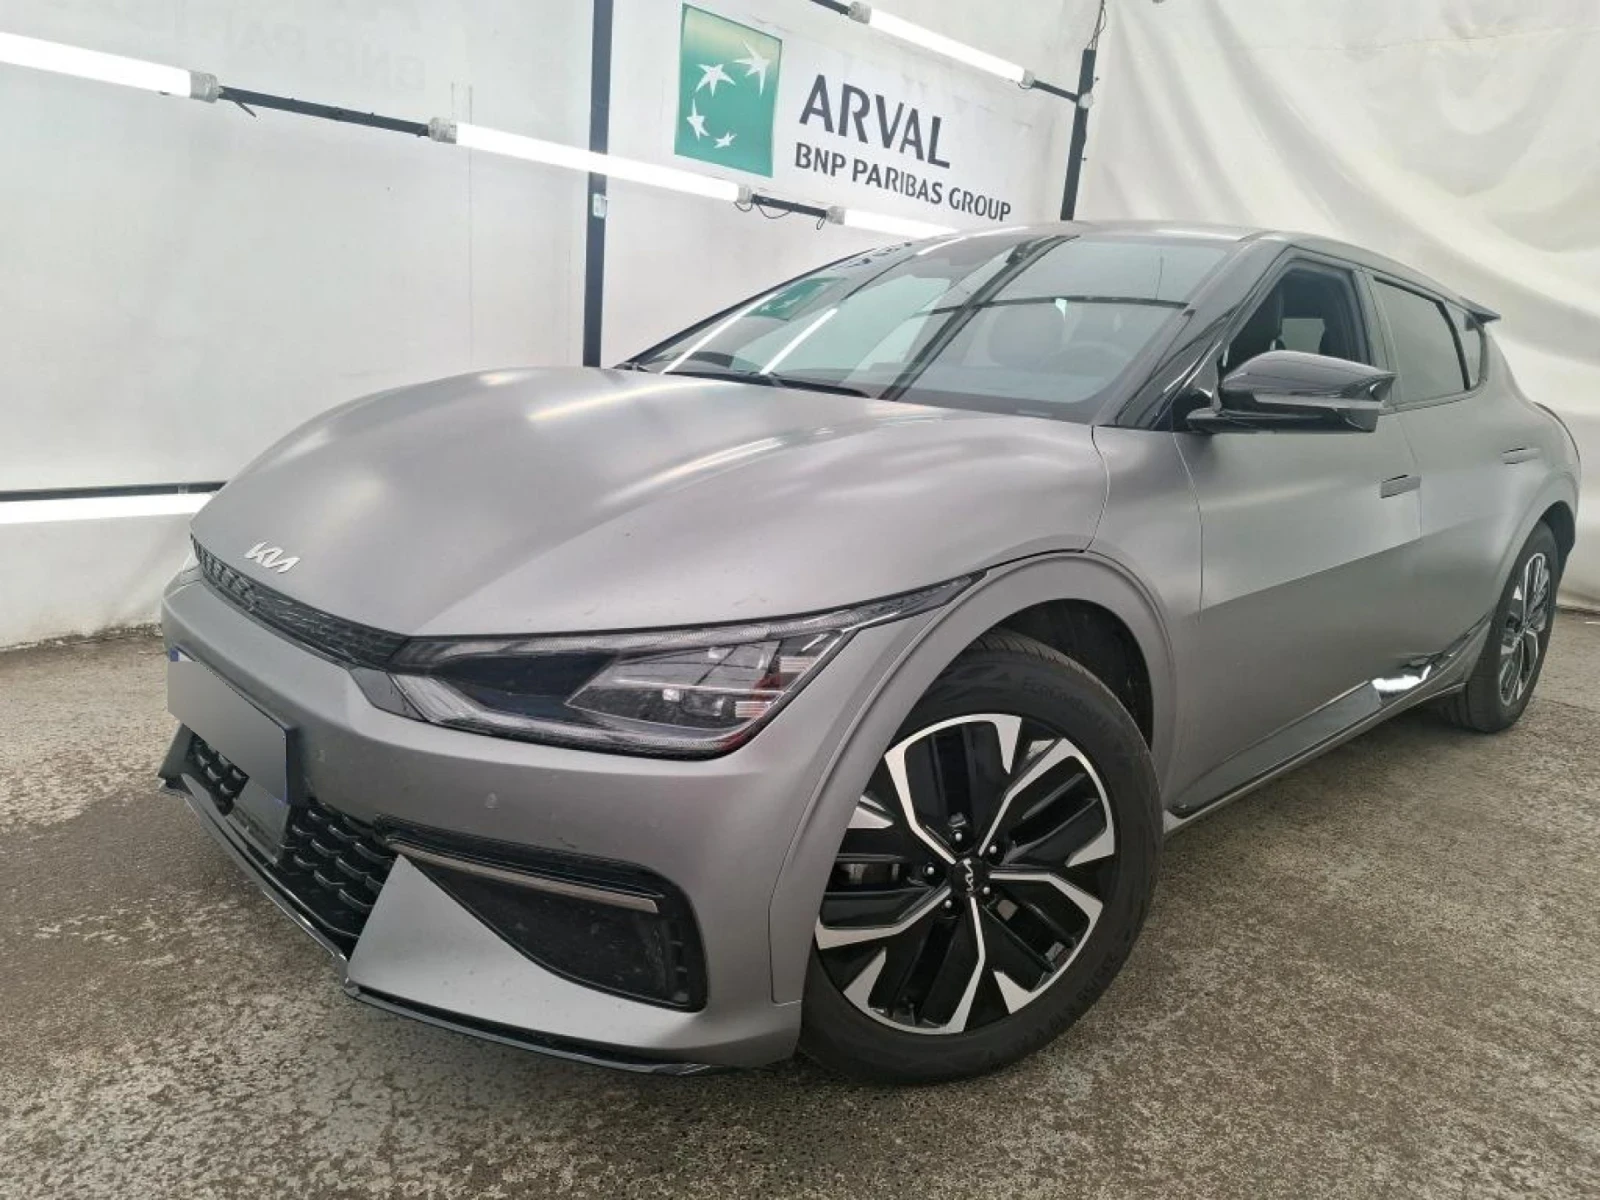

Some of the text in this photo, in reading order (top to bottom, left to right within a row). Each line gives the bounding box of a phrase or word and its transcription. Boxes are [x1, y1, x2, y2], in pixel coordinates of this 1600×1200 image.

[799, 74, 950, 169] ARVAL
[795, 142, 1012, 222] BNP PARIBAS GROUP
[244, 541, 301, 573] KIA
